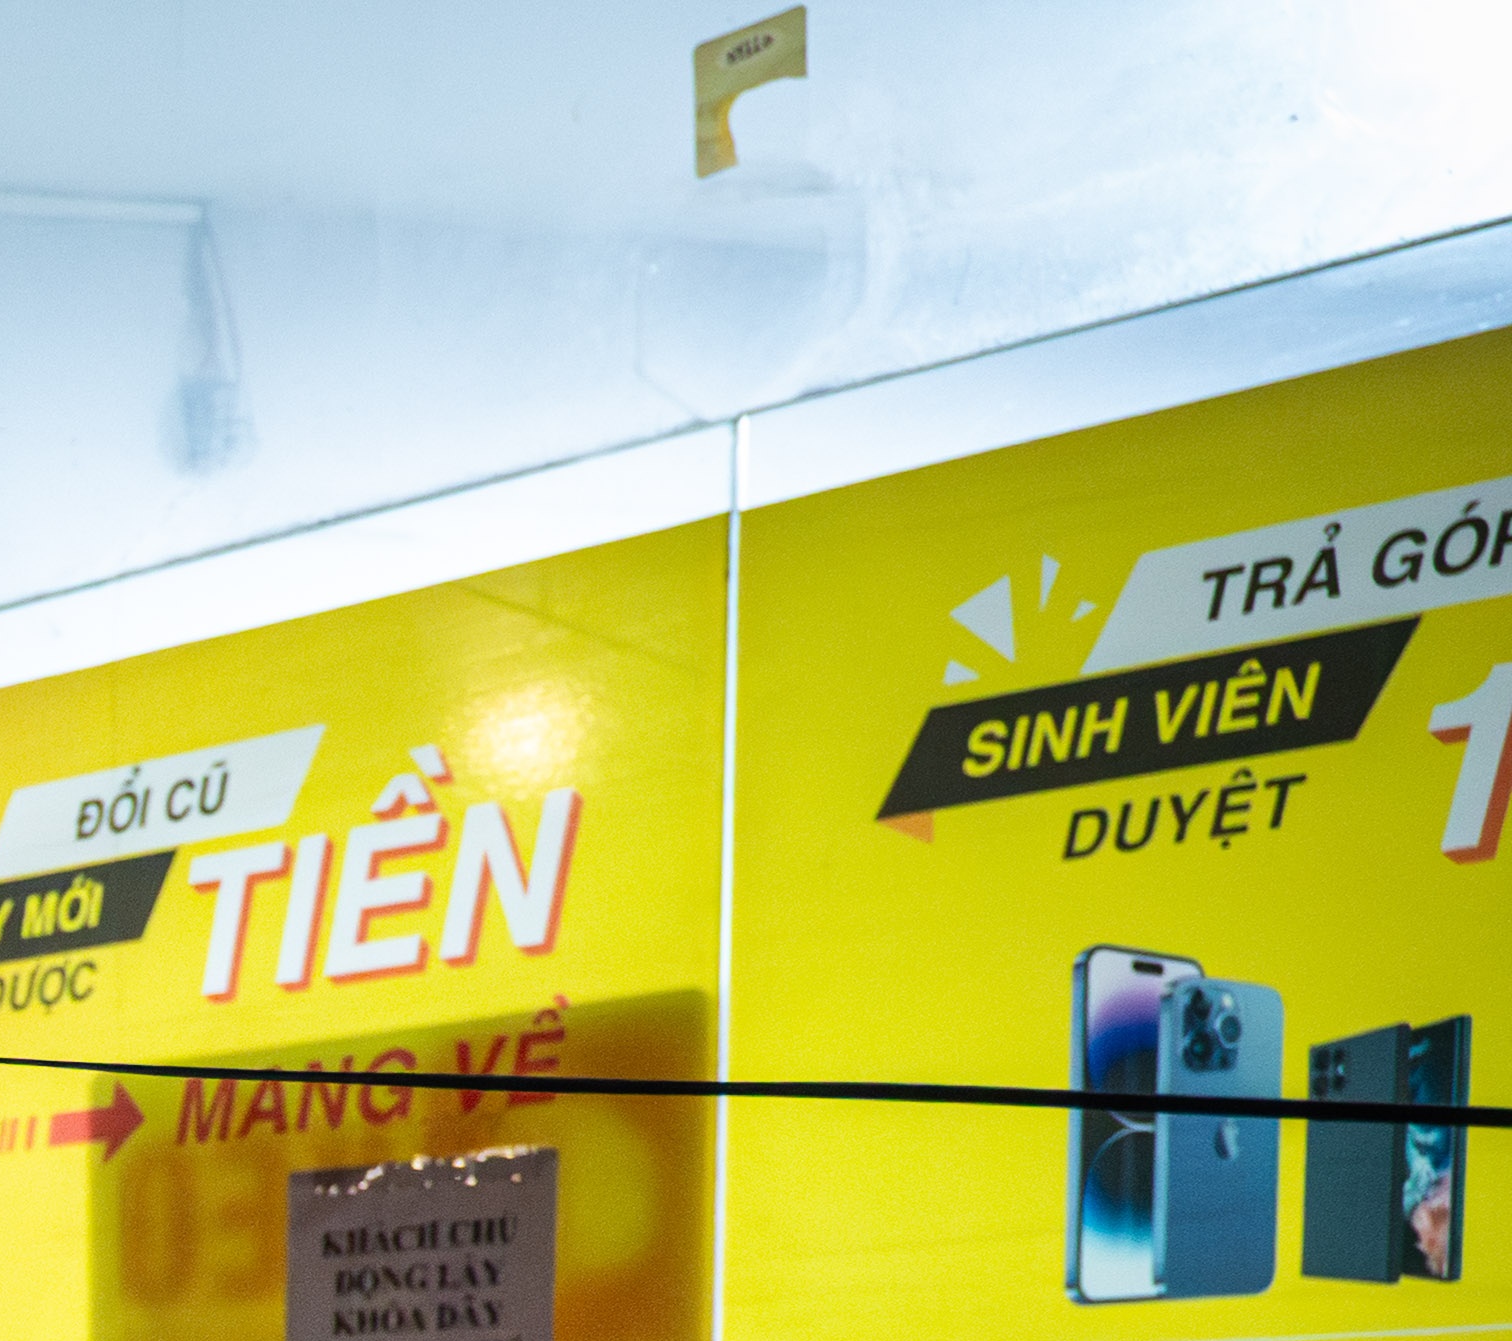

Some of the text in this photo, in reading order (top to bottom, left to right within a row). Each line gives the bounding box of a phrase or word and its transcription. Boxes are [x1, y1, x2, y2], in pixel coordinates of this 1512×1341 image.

[1203, 523, 1342, 622] TRẢ
[963, 658, 1321, 778] SINH VIÊN
[75, 763, 232, 841] ĐỔI CŨ
[1061, 769, 1307, 862] DUYỆT
[20, 876, 106, 939] MỚI
[187, 742, 584, 1004] TIỀN
[175, 993, 569, 1147] MANG VỀ
